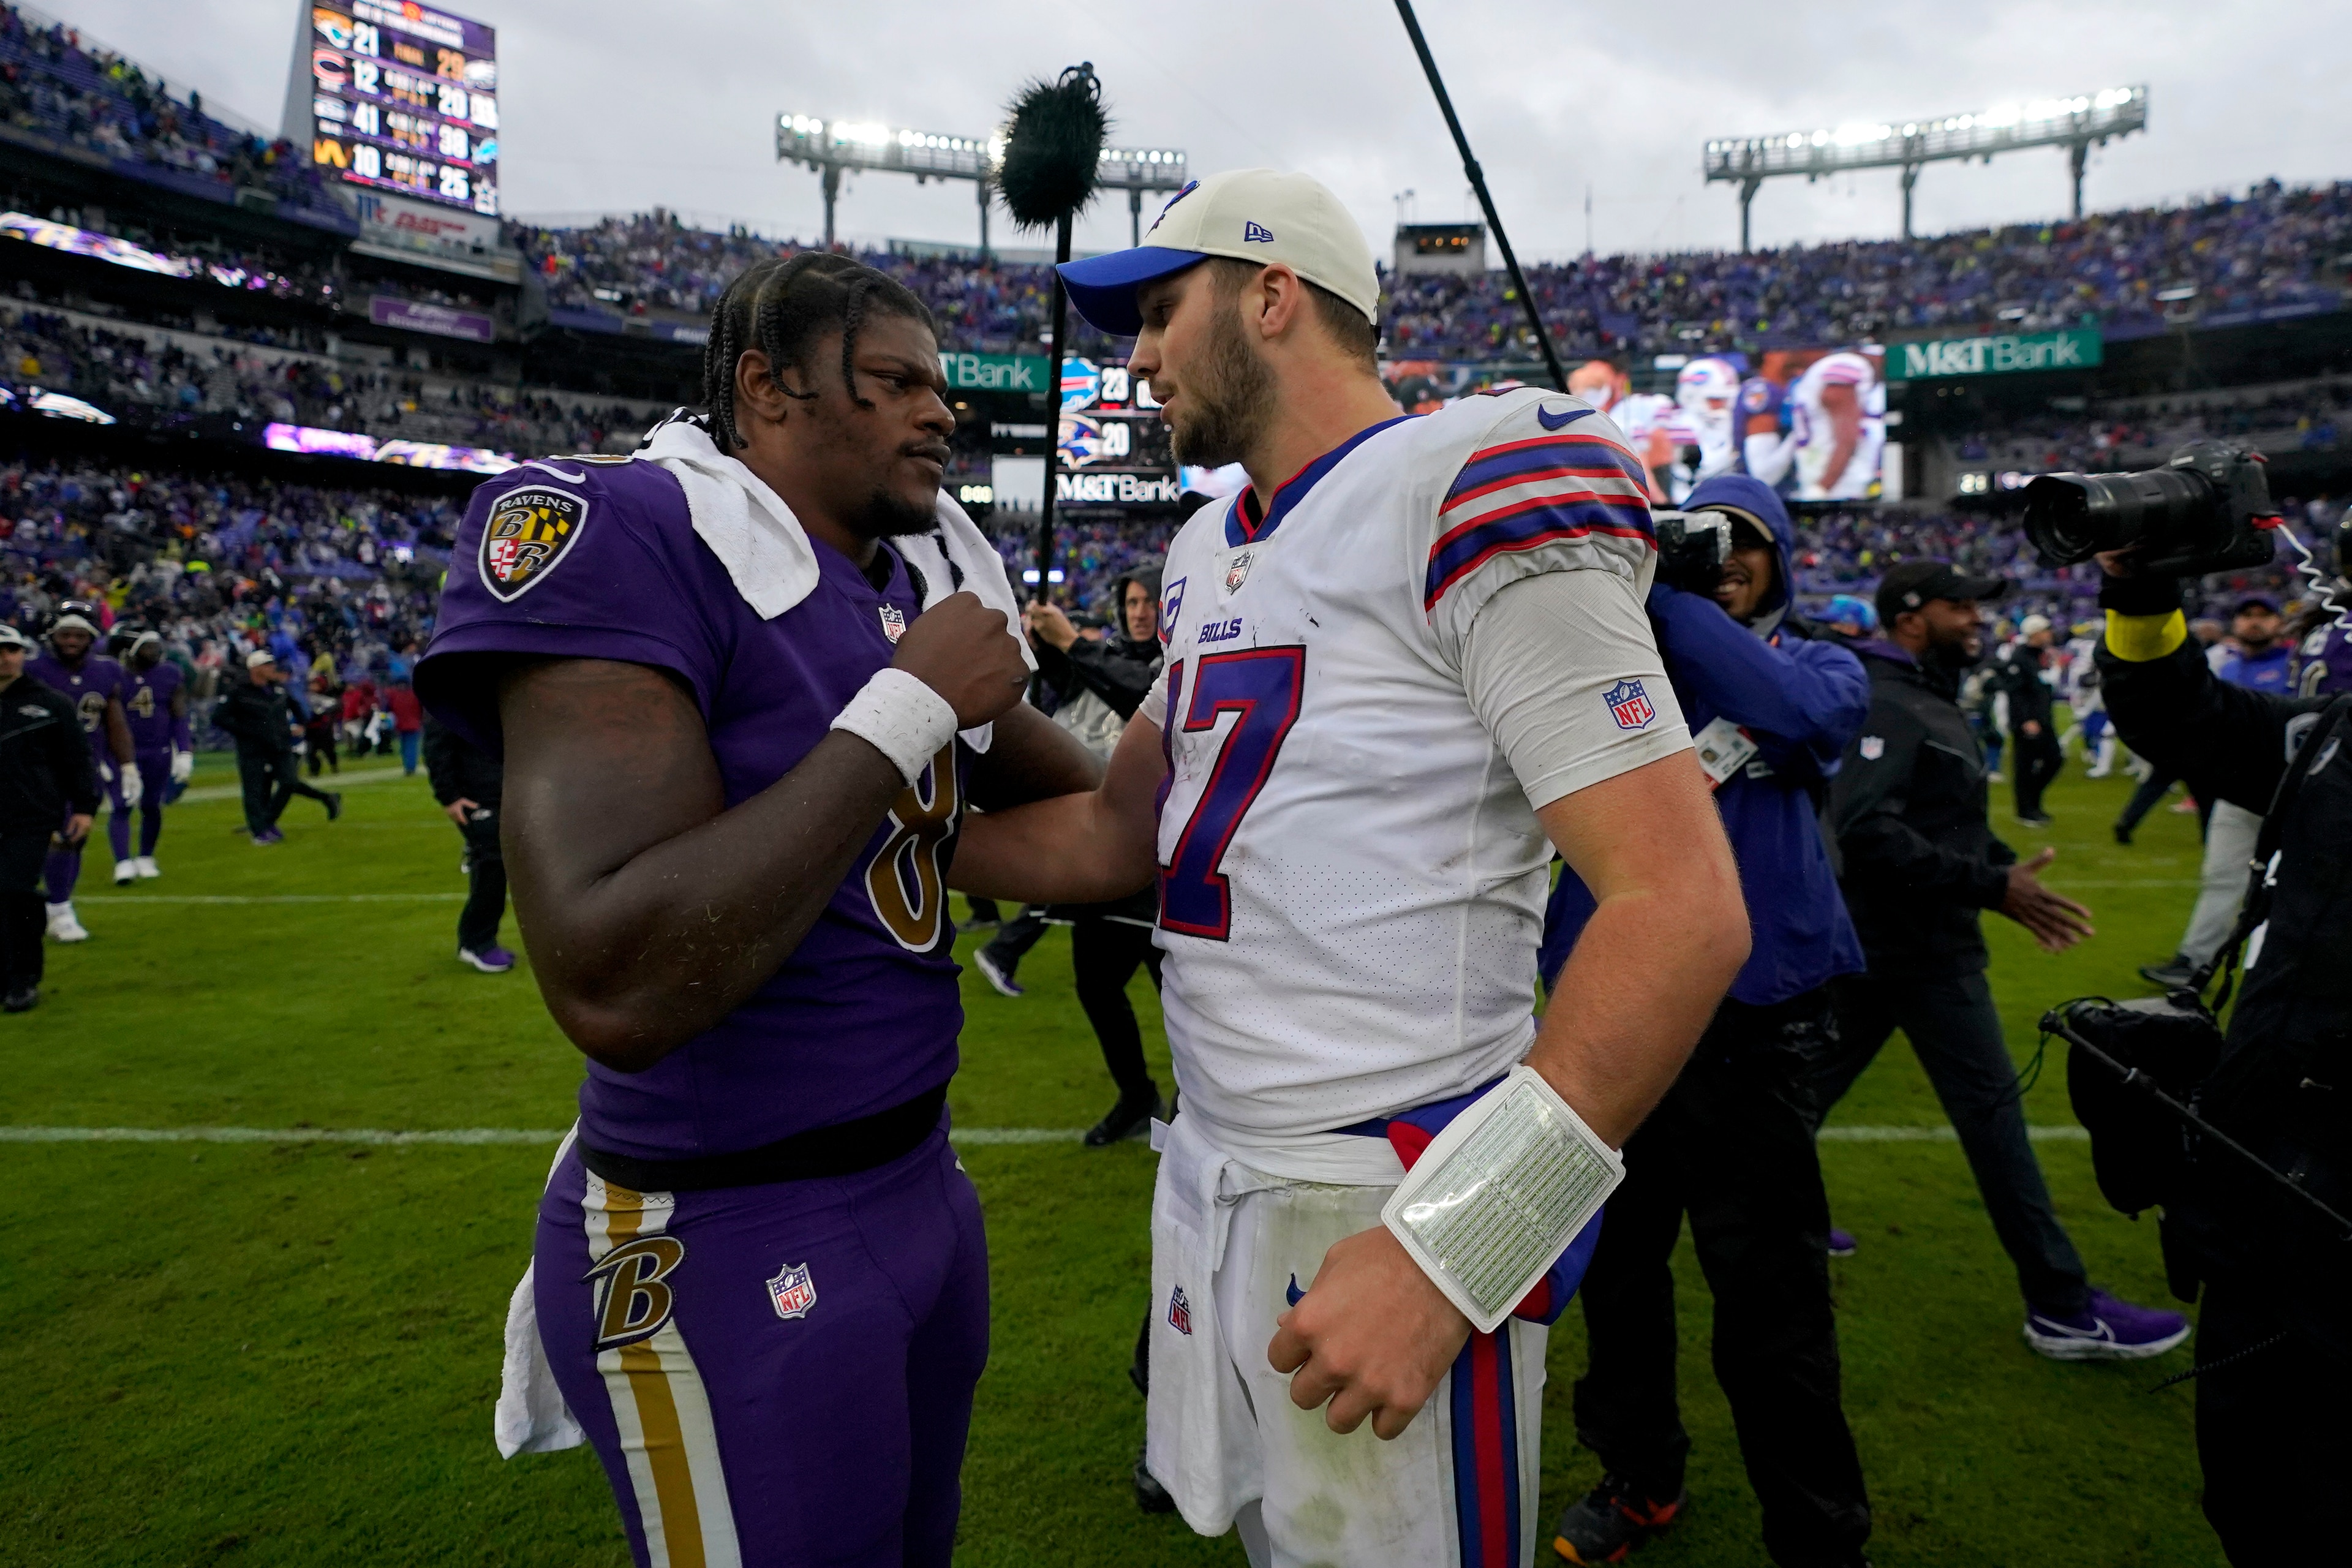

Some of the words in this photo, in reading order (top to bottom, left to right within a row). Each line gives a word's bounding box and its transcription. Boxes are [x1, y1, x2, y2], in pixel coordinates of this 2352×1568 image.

[353, 21, 379, 57] 21
[352, 59, 379, 95] 12
[353, 102, 380, 137] 41
[353, 143, 381, 178] 10
[958, 353, 1035, 389] Bank
[1905, 337, 1992, 377] M&T
[1993, 333, 2083, 371] Bank
[1101, 368, 1129, 401] 23
[1102, 422, 1130, 456] 20
[499, 494, 573, 513] RAVENS
[1055, 473, 1119, 502] M&T
[1119, 474, 1178, 502] Bank
[494, 509, 531, 538] B
[1198, 617, 1243, 644] BILLS
[1614, 698, 1653, 725] NFL
[581, 1235, 686, 1349] B
[778, 1284, 810, 1312] NFL
[1172, 1302, 1192, 1333] NFL
